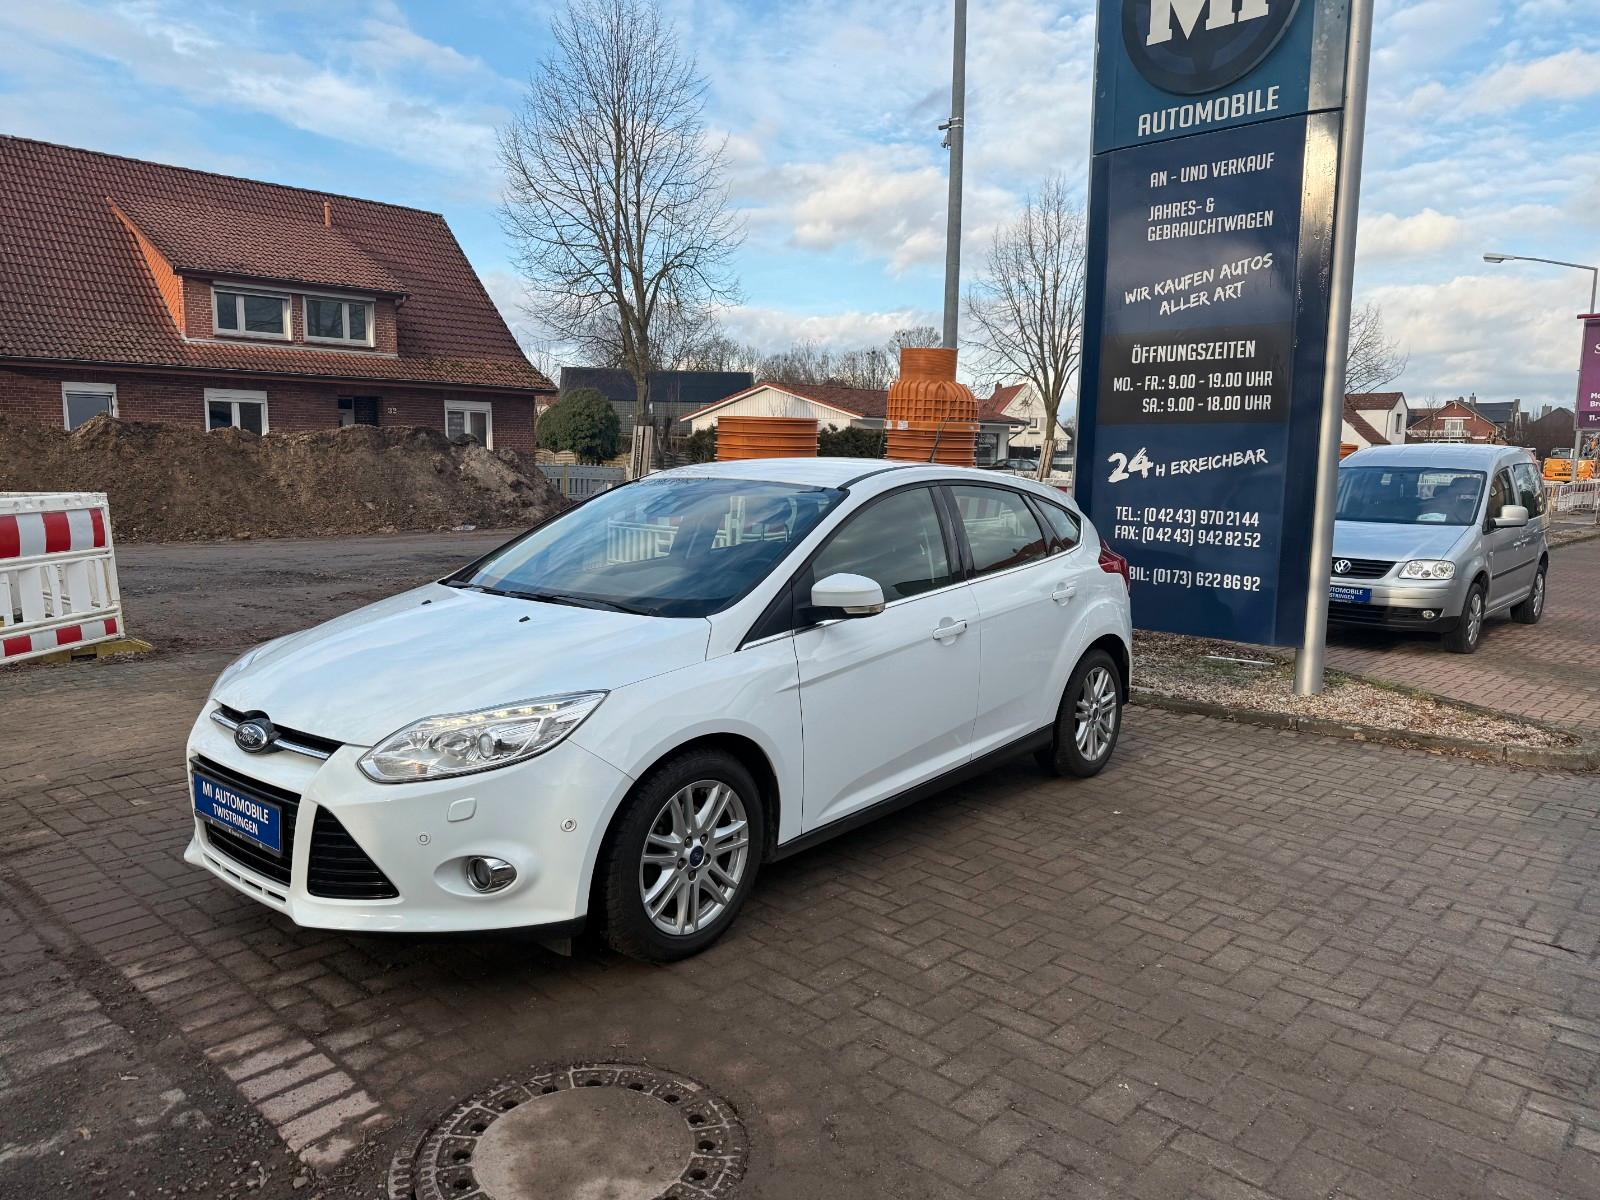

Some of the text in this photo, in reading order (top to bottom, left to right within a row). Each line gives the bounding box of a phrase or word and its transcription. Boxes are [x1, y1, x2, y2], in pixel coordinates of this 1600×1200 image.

[1137, 85, 1280, 137] AUTOMOBILE
[1150, 171, 1167, 188] AN
[1180, 164, 1208, 183] UND
[1212, 152, 1275, 178] VERKAUF
[1147, 210, 1274, 242] GEBRAUCHTWAGEN
[1148, 198, 1215, 222] JAHRES- &
[1125, 252, 1273, 305] WIR KAUFEN AUTOS
[1159, 280, 1245, 316] ALLER ART
[1131, 340, 1256, 364] ÖFFNUNGSZEITEN
[1113, 377, 1134, 392] MO.
[1144, 375, 1165, 391] FR.:
[1168, 374, 1196, 389] 9.00
[1208, 372, 1242, 388] 19.00
[1246, 370, 1273, 387] UHR
[1142, 398, 1164, 413] SA.:
[1167, 397, 1195, 412] 9.00
[1207, 395, 1241, 411] 18.00
[1244, 394, 1272, 410] UHR
[1107, 447, 1269, 483] 24 H ERREICHBAR
[1115, 506, 1141, 521] TEL.:
[1114, 525, 1139, 540] FAX:
[1129, 565, 1150, 581] BIL:
[202, 780, 269, 825] MI AUTOMOBILE
[212, 803, 258, 836] TWISTRINGEN
